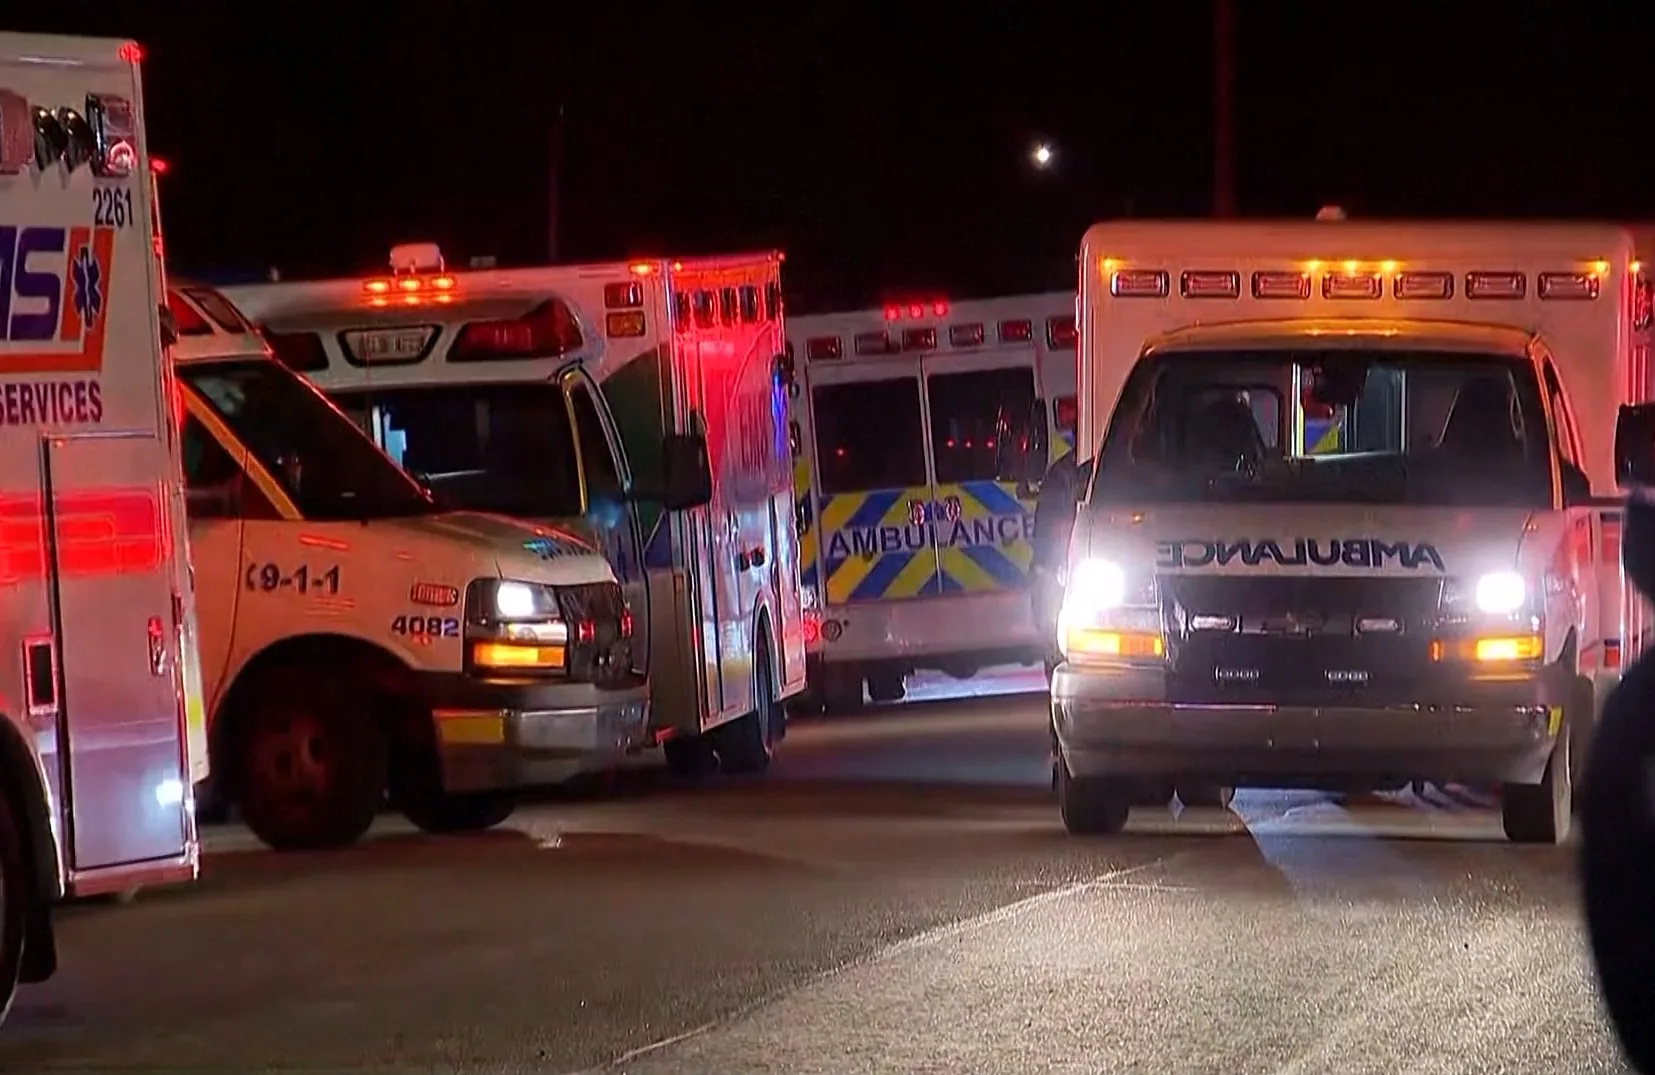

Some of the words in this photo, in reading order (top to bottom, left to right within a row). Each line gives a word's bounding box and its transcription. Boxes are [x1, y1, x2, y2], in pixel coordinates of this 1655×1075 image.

[92, 187, 134, 228] 2261
[0, 226, 65, 342] S
[260, 563, 340, 595] 9-1-1
[391, 615, 459, 637] 4082
